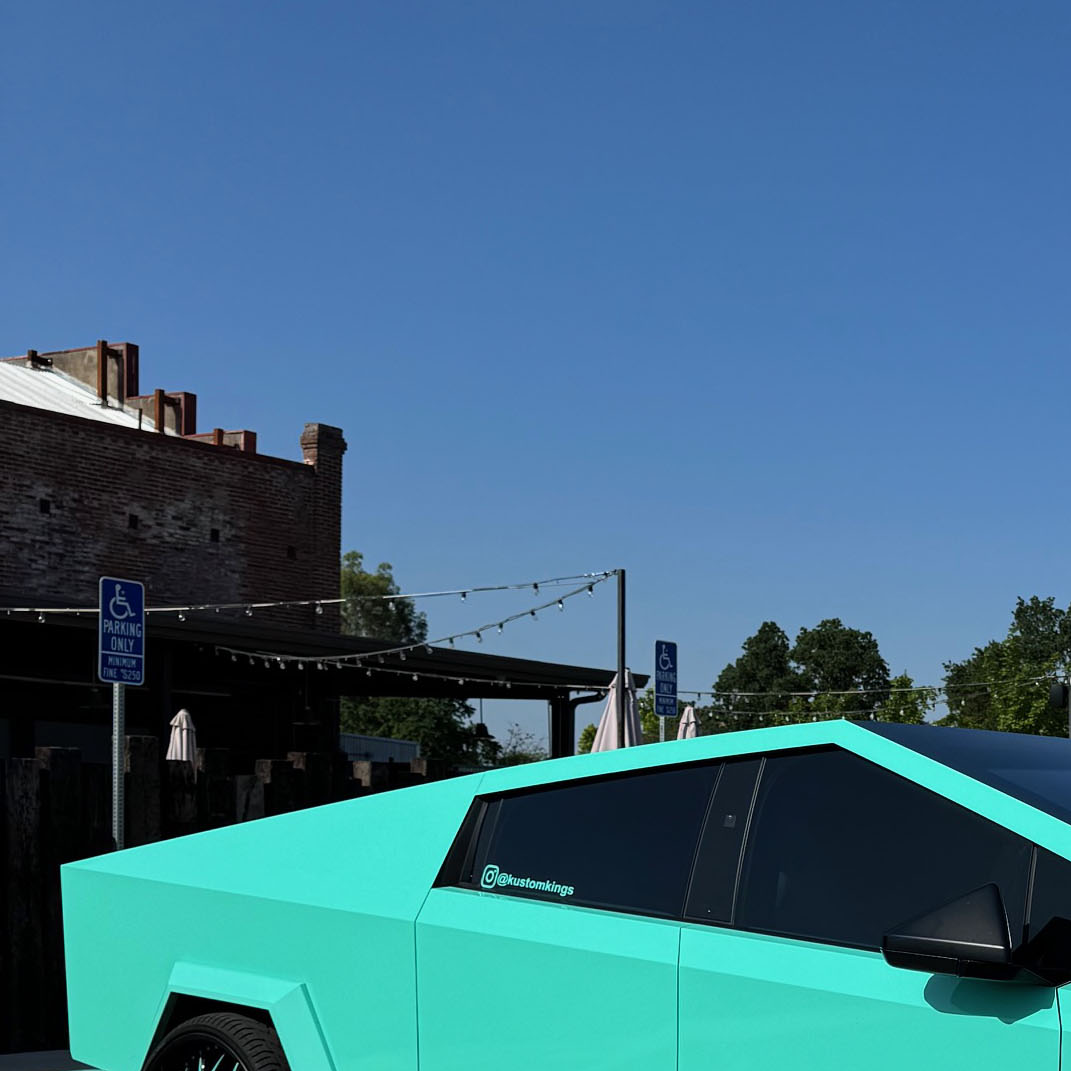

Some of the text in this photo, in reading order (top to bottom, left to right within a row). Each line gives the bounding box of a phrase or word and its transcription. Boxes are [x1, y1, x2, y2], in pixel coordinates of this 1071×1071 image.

[103, 619, 142, 637] PARKING
[111, 636, 134, 652] ONLY
[107, 656, 137, 668] MINIMUM
[103, 667, 141, 681] FINE $250
[497, 873, 575, 897] @kustomkings
